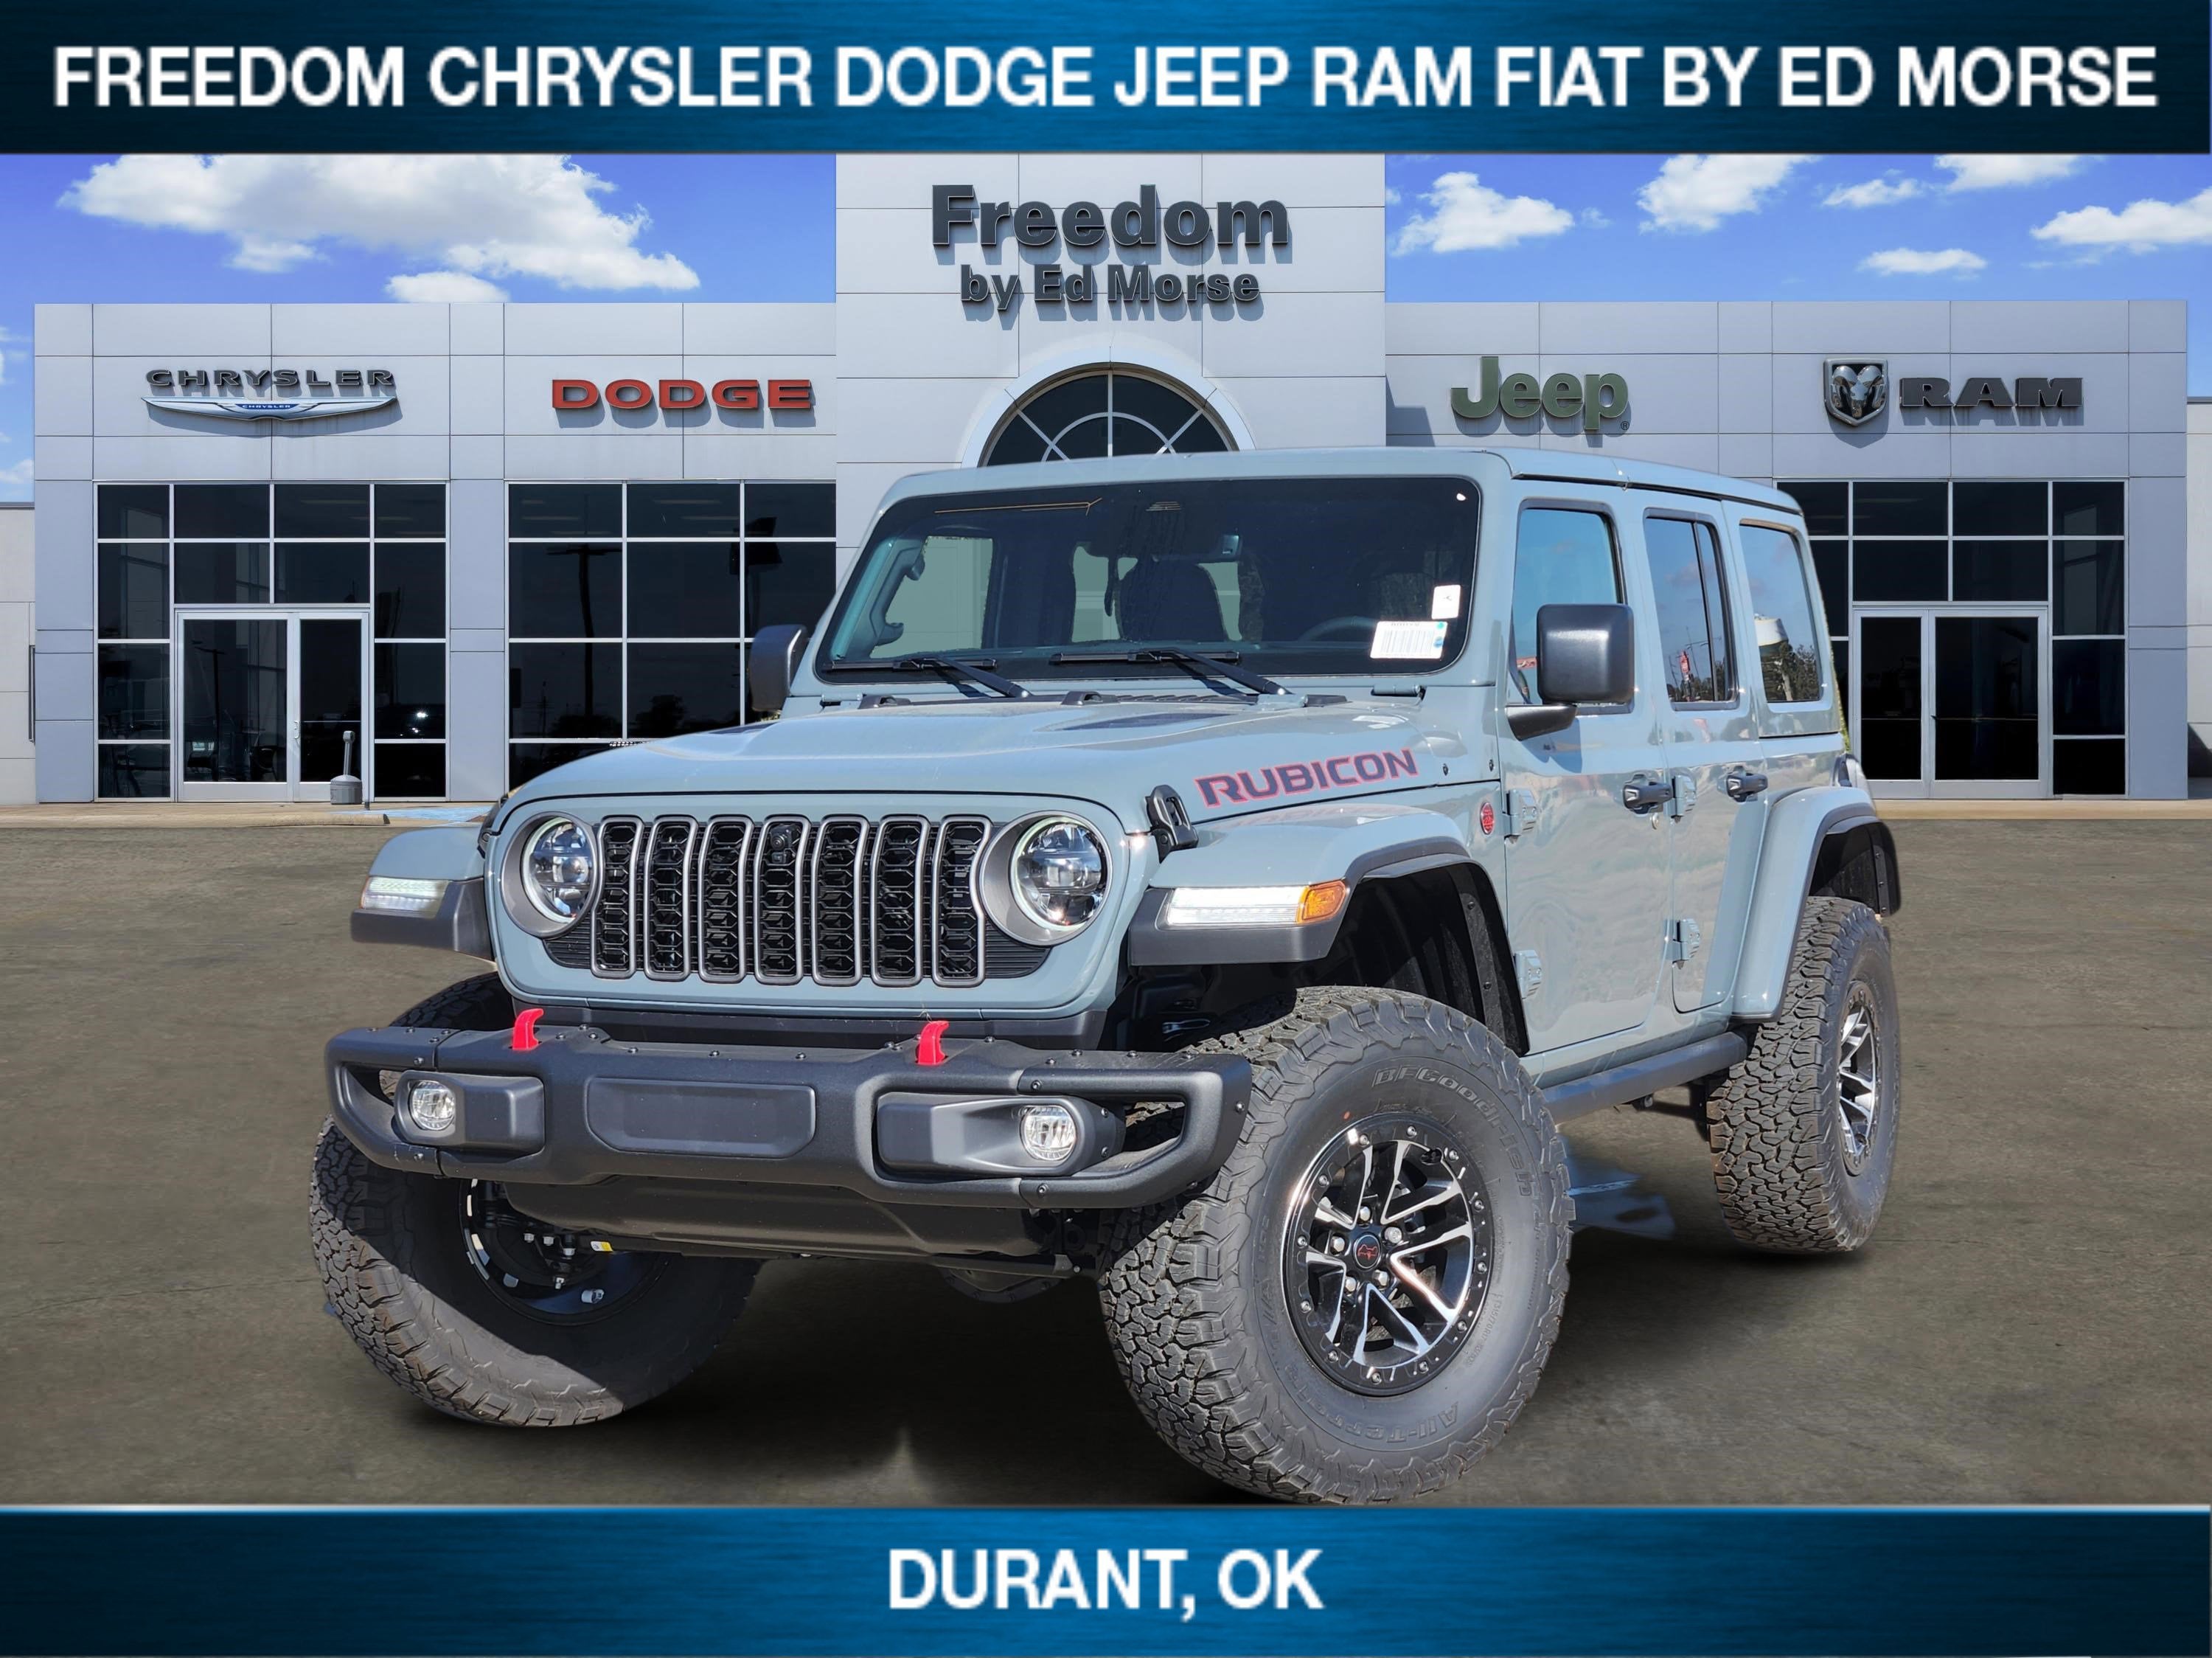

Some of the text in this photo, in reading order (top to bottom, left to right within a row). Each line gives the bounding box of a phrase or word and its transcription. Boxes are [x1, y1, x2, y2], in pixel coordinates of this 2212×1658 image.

[931, 184, 1289, 246] Freedom
[960, 263, 1261, 311] by Ed Morse
[145, 368, 395, 387] CHRYSLER
[552, 378, 812, 409] DODGE
[1450, 355, 1629, 430] Jeep
[1899, 377, 2084, 407] RAM
[1195, 749, 1419, 807] RUBICON
